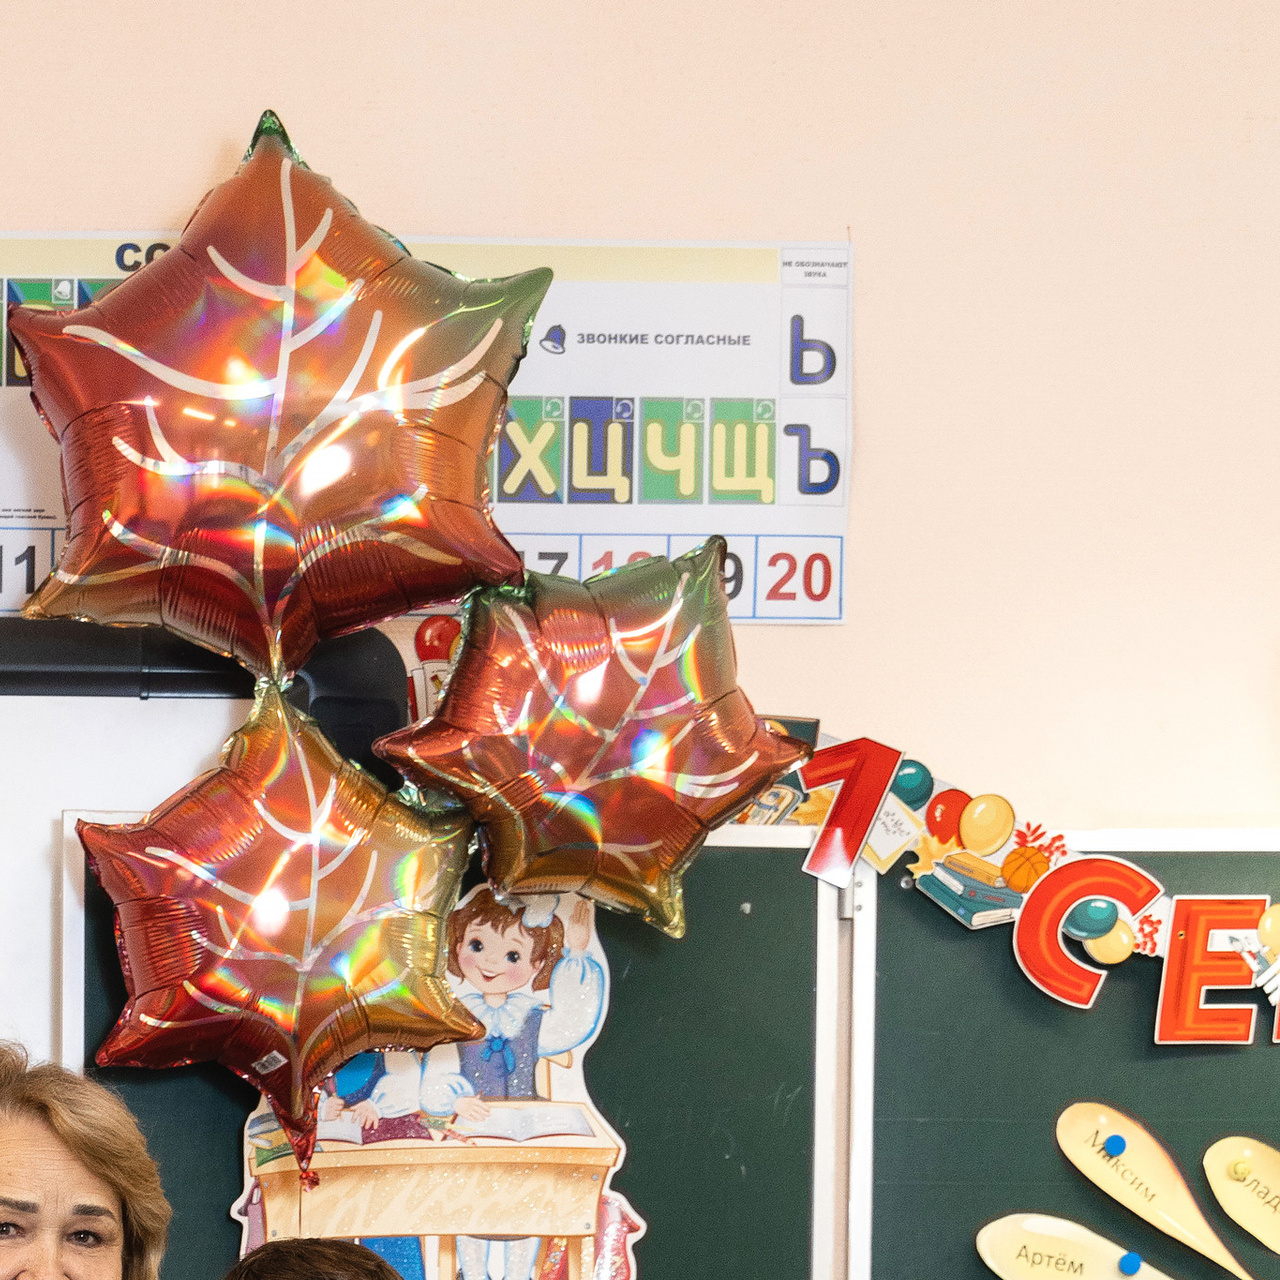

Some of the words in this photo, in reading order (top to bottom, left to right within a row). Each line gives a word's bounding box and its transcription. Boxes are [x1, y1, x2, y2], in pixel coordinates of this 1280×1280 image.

[576, 332, 649, 345] ЗВОНКИЕ
[653, 333, 752, 346] СОГЛАСНЫЕ
[765, 552, 834, 603] 20
[1013, 854, 1280, 1045] СЕ
[1015, 1244, 1085, 1276] Артём
